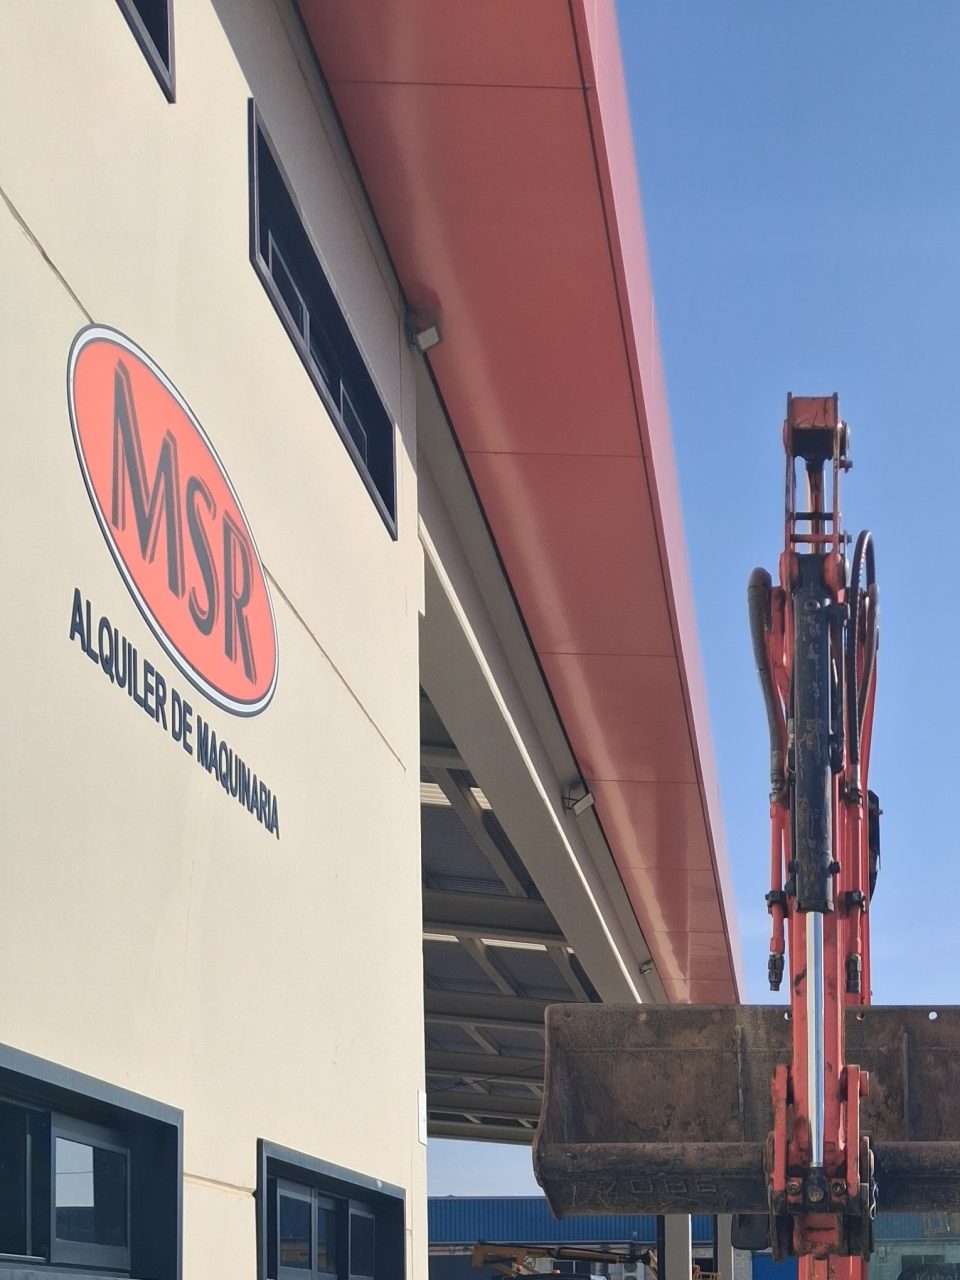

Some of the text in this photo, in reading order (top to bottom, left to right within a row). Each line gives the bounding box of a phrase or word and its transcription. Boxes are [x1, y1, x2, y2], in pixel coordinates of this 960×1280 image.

[110, 357, 257, 686] MSR
[69, 587, 280, 841] ALQUILER DE MAQUINARIA
